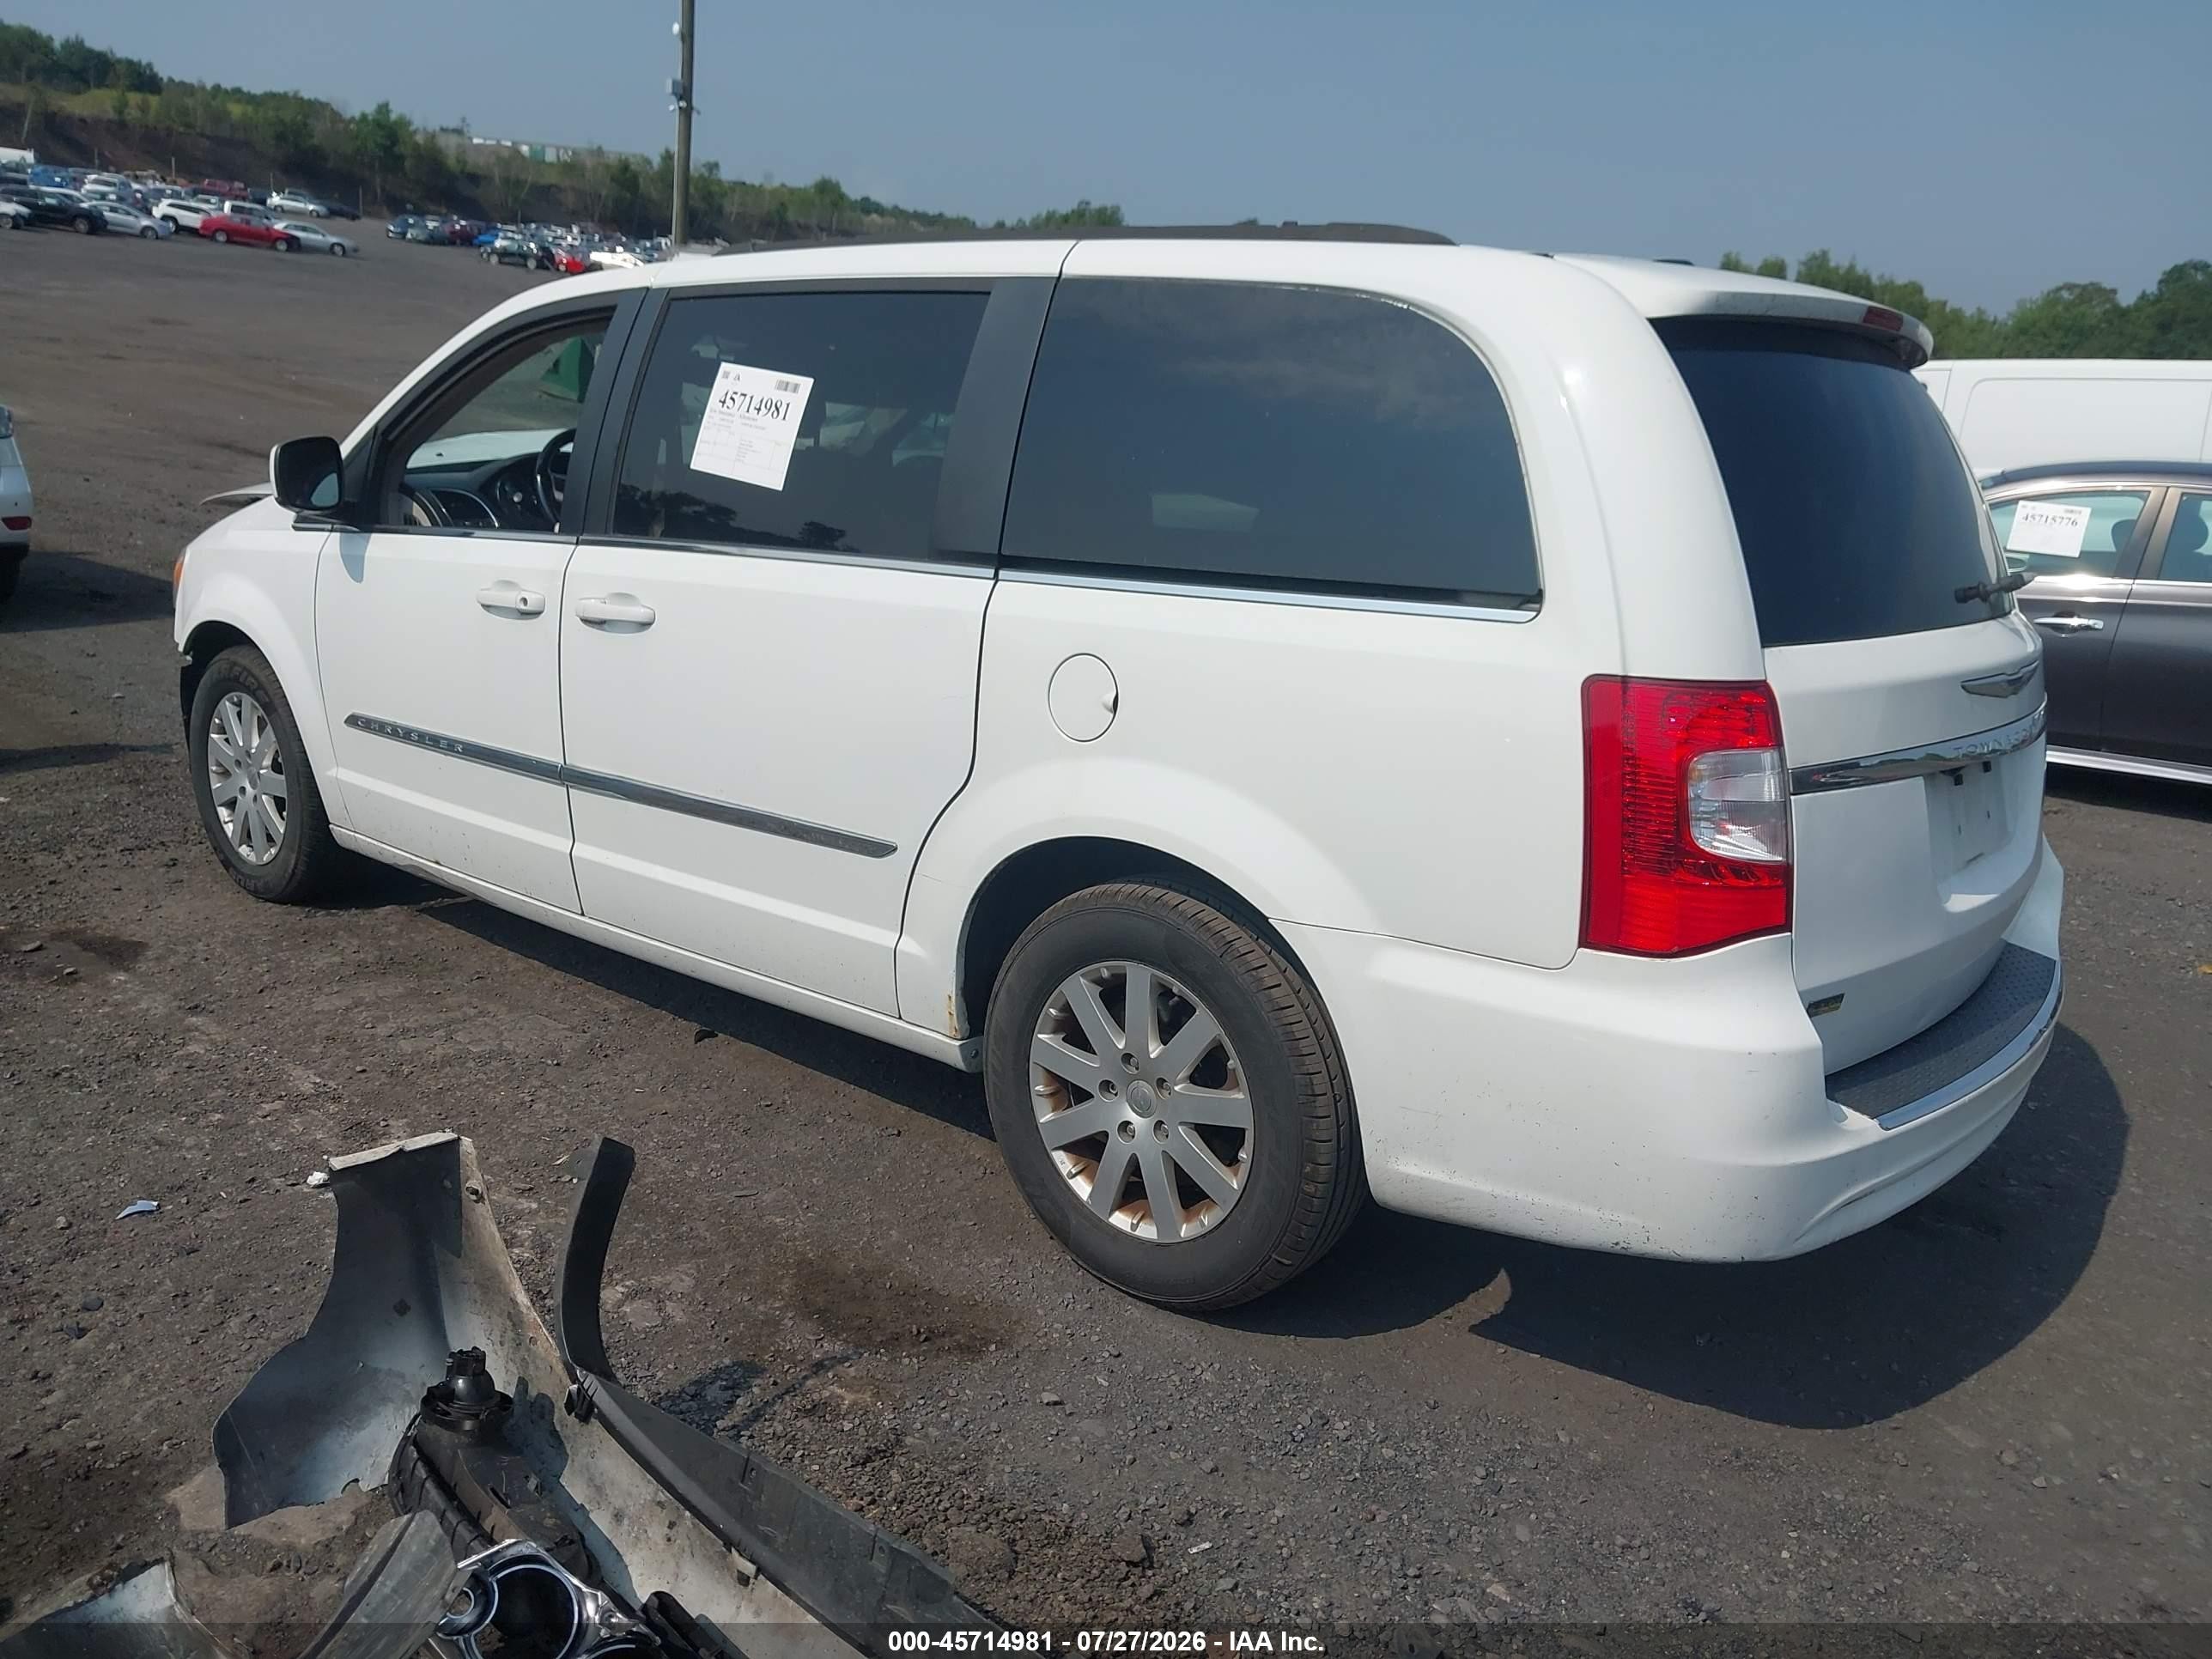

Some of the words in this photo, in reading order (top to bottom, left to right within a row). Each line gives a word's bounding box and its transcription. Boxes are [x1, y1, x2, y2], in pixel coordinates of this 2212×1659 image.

[719, 389, 790, 421] 45714981
[2021, 513, 2079, 527] 45715776
[357, 719, 463, 752] CHRYSLER
